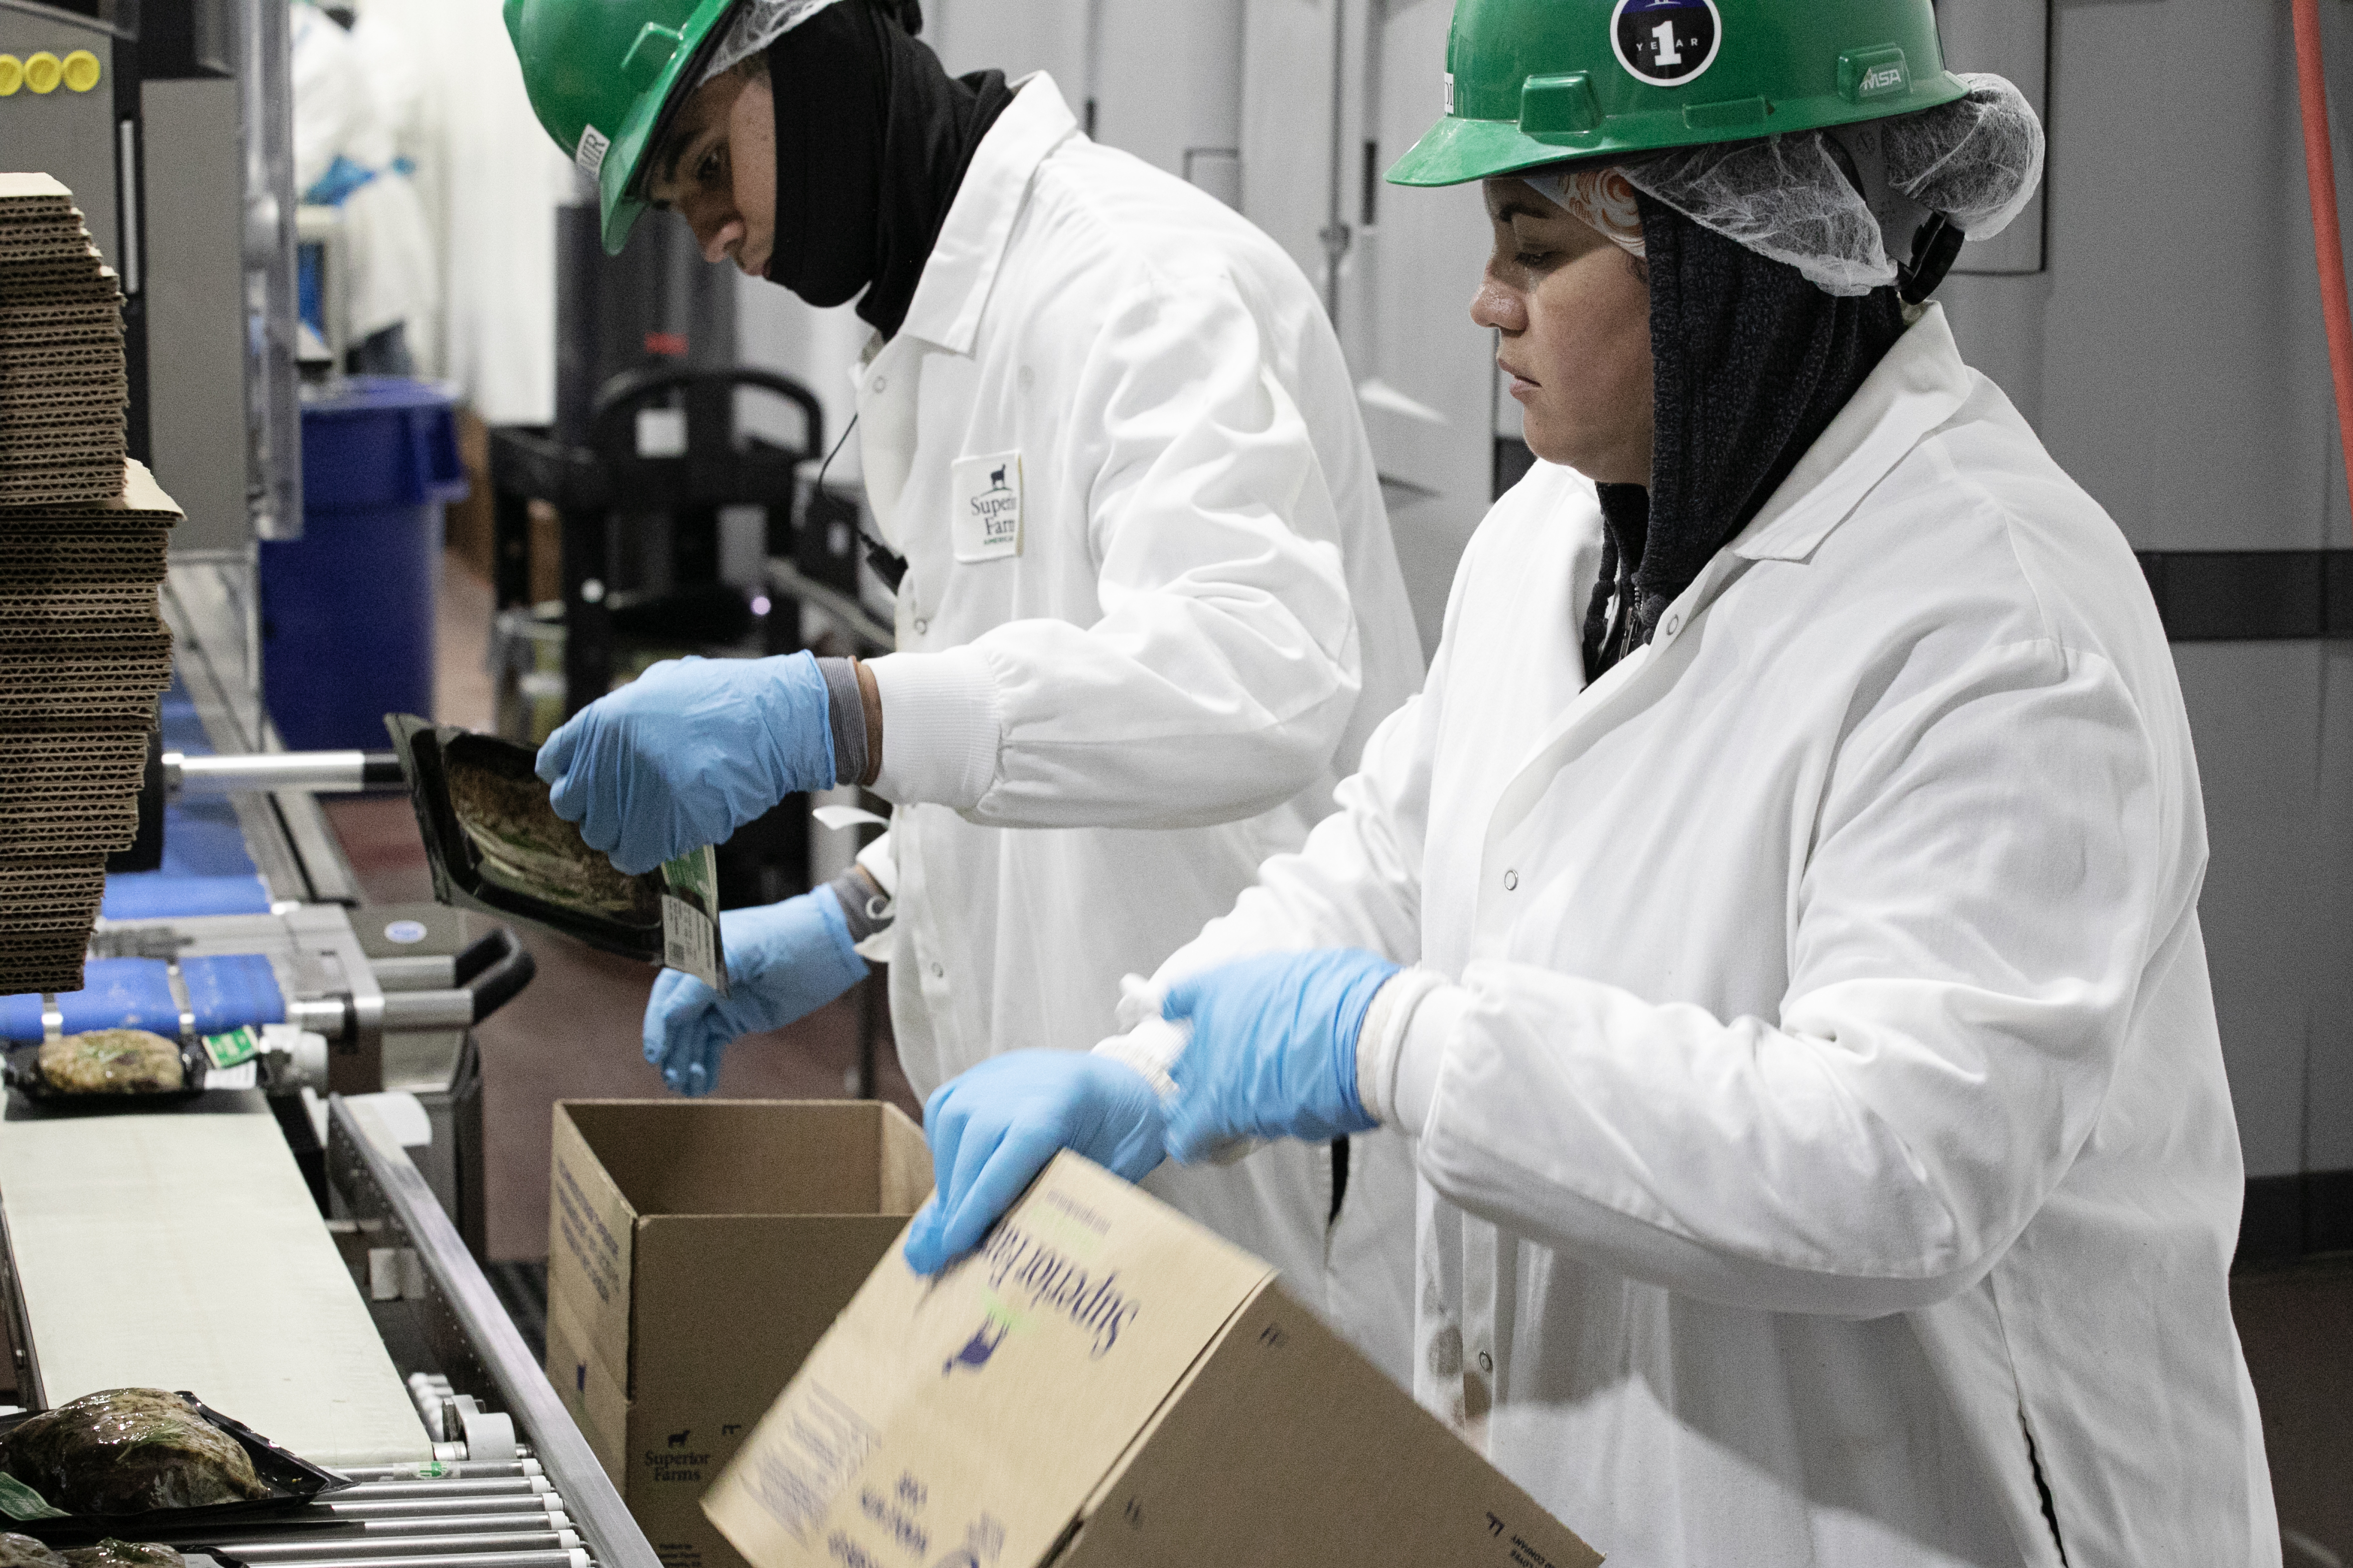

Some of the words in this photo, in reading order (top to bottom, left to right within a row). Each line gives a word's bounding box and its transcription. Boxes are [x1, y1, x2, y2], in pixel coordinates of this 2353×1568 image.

[1652, 20, 1682, 66] 1
[1859, 69, 1902, 91] MSA
[1012, 1241, 1141, 1362] Superior
[645, 1449, 710, 1469] Superior
[654, 1466, 701, 1481] Farms
[1511, 1534, 1545, 1565] COMPANY
